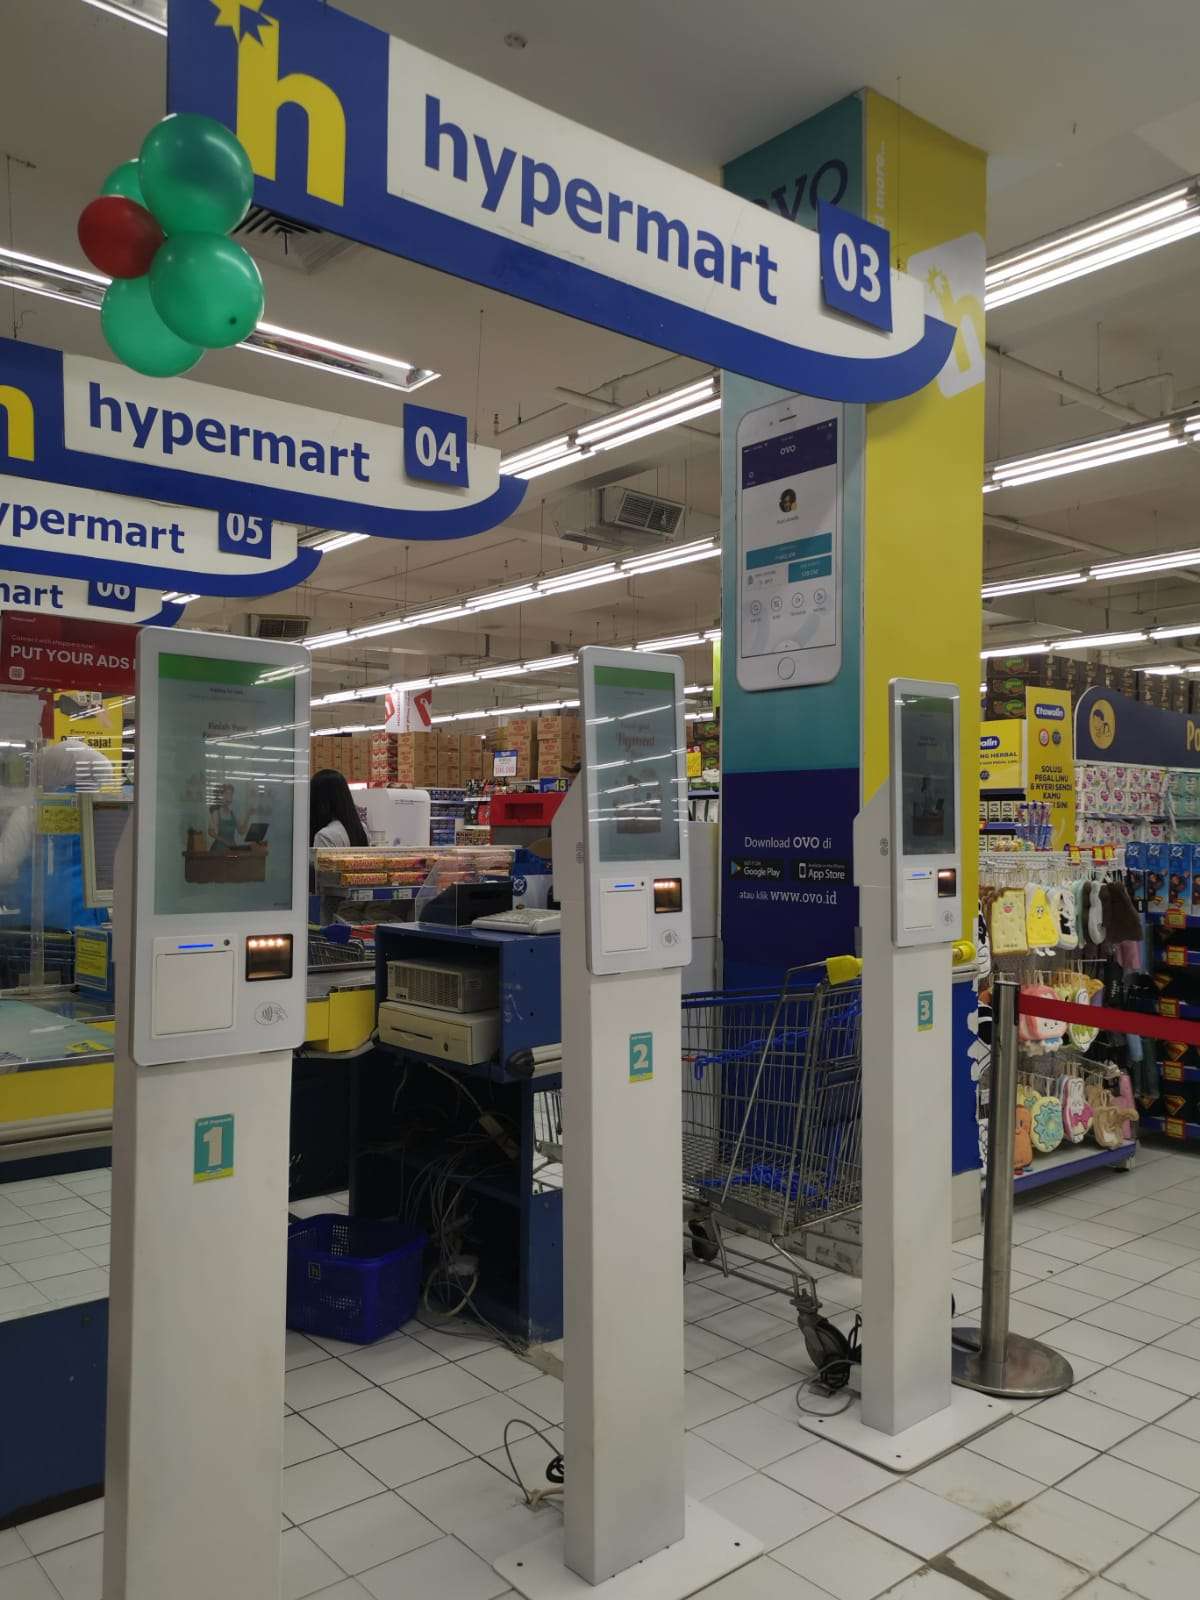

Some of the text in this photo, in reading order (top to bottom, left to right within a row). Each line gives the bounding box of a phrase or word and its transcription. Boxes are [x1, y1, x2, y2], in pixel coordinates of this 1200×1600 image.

[425, 93, 779, 306] hypermart
[753, 158, 849, 222] VO
[832, 230, 883, 304] 03
[88, 381, 371, 483] hypermart
[414, 425, 461, 473] 04
[226, 513, 264, 545] 05
[10, 644, 44, 660] PUT
[45, 649, 95, 667] YOUR
[96, 655, 131, 670] ADS
[87, 737, 112, 749] saja!
[555, 779, 567, 792] 15
[1034, 774, 1069, 783] PEGAL LINU
[1036, 783, 1055, 791] NYERI
[744, 836, 832, 849] Download OVO di
[743, 866, 781, 878] Google Play
[808, 869, 846, 880] App Store
[769, 890, 837, 905] www.ovo.id
[919, 999, 930, 1022] 3
[632, 1043, 649, 1070] 2
[202, 1126, 223, 1167] 1
